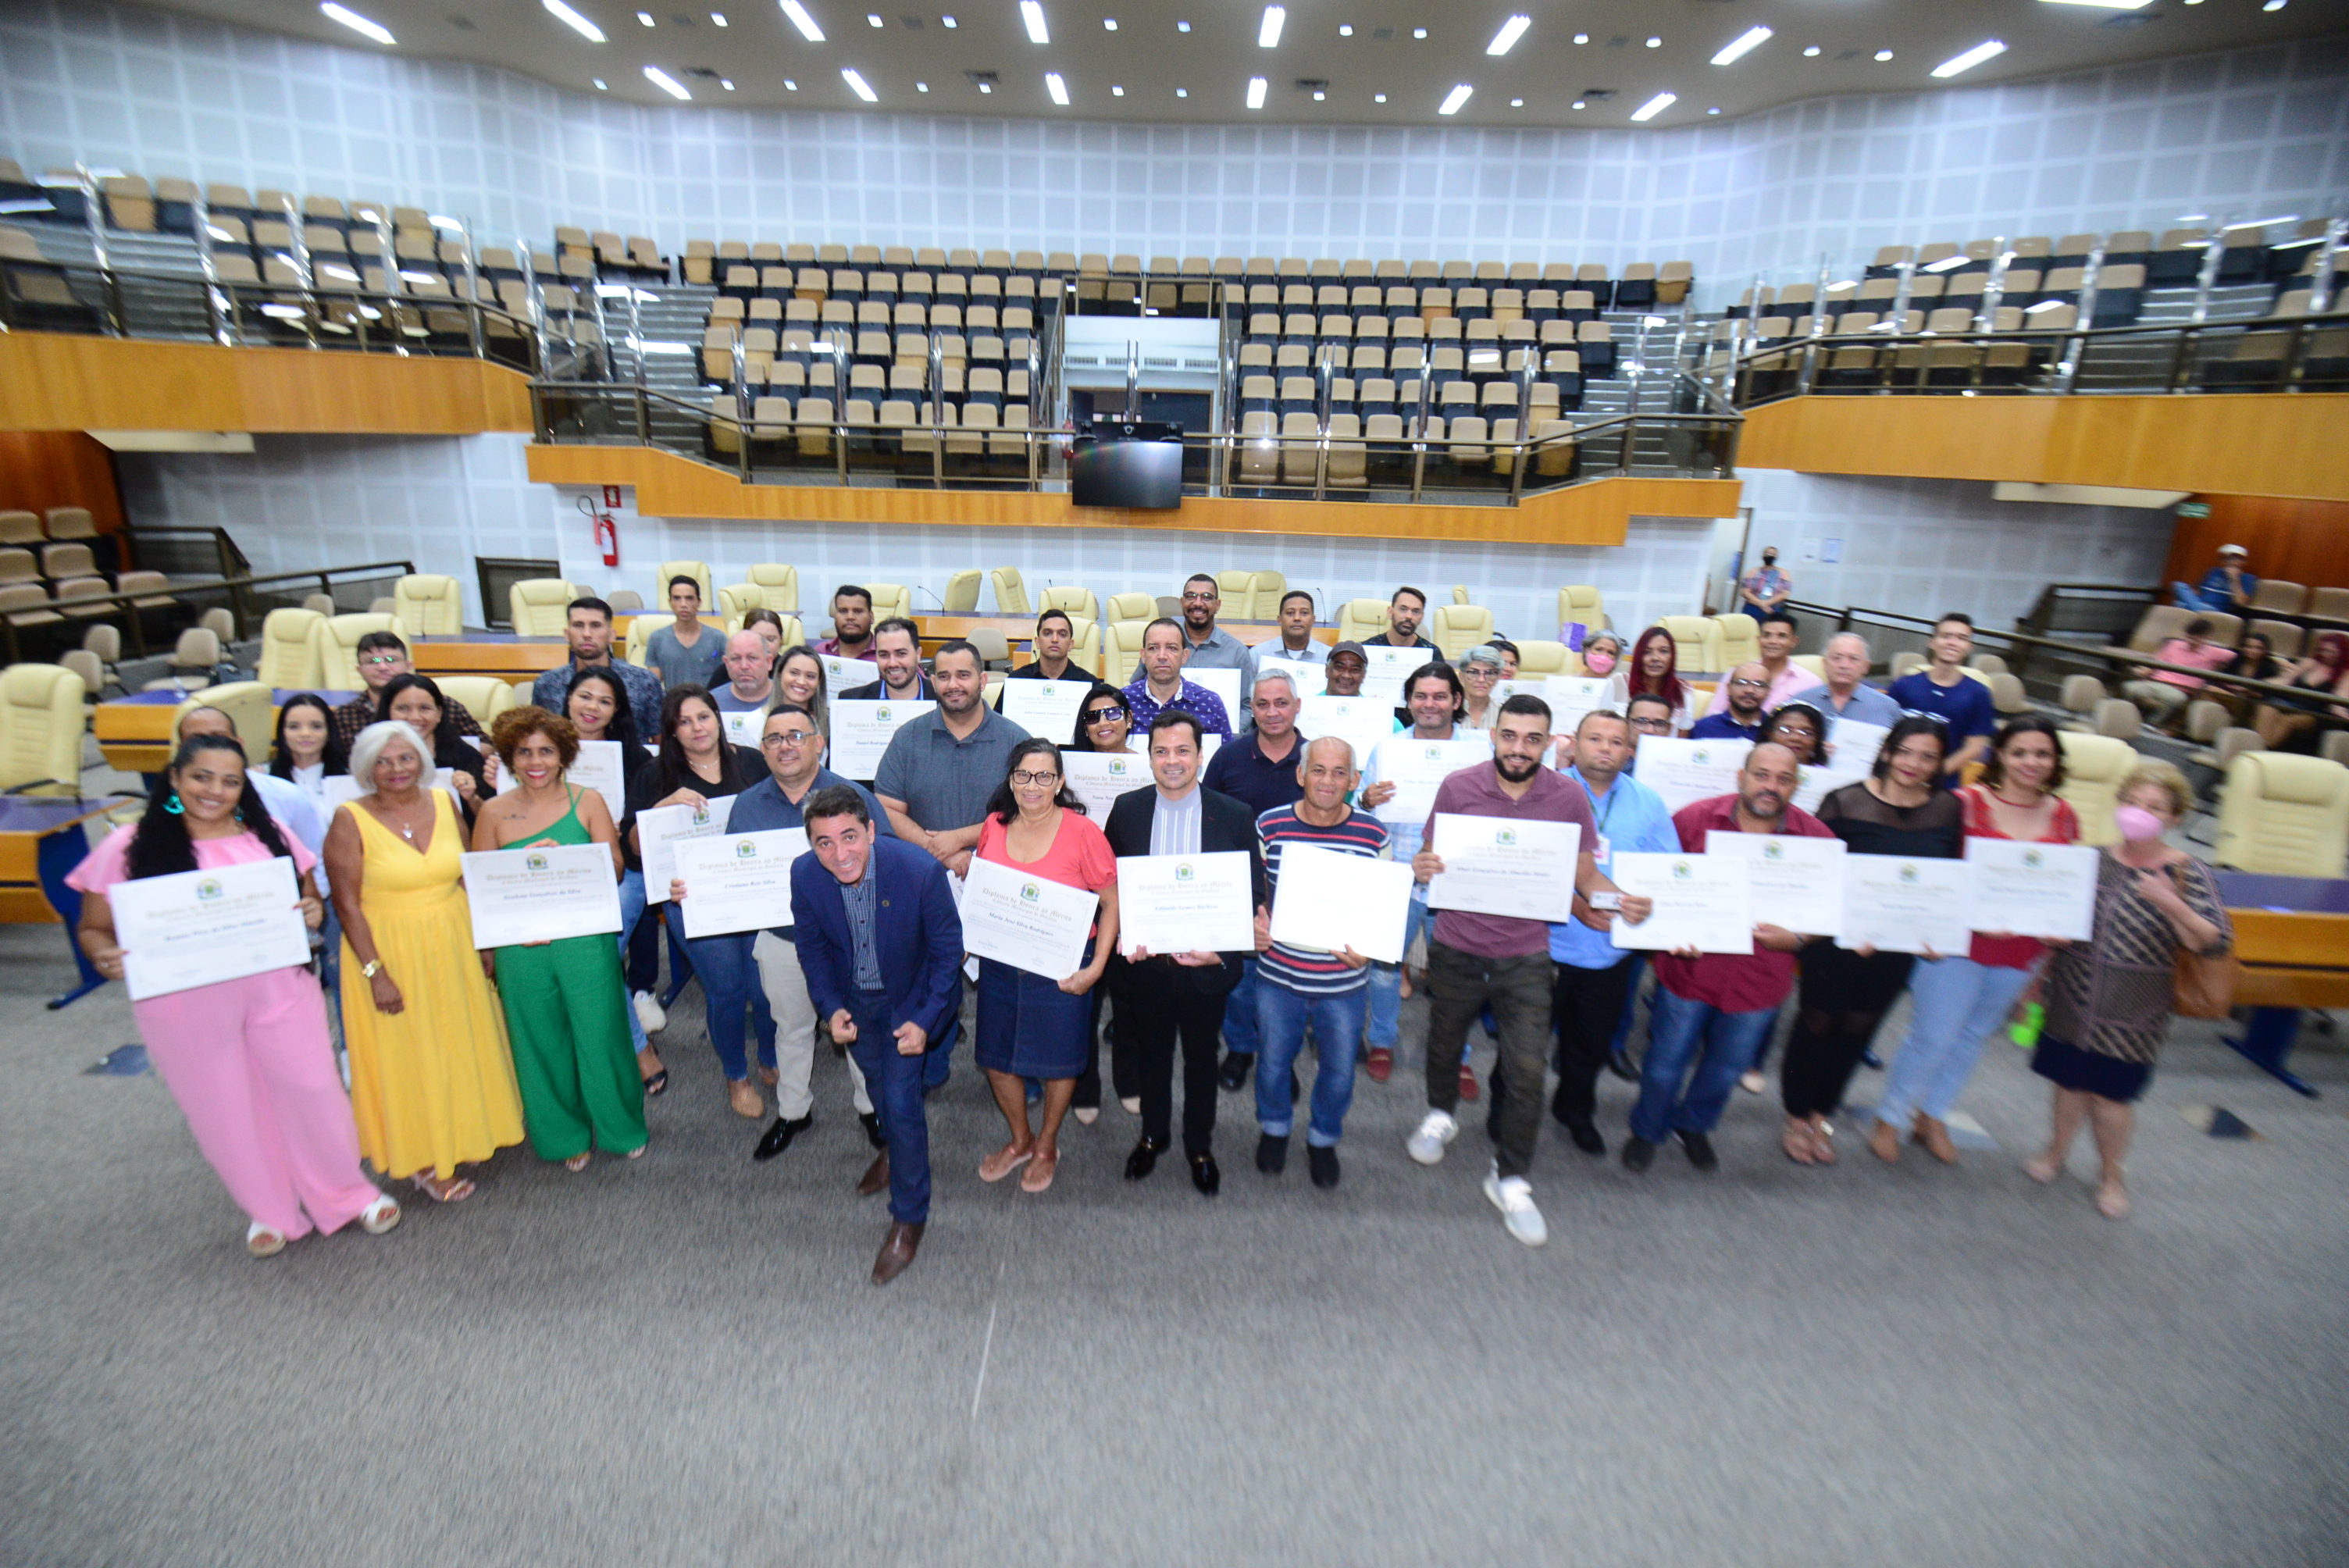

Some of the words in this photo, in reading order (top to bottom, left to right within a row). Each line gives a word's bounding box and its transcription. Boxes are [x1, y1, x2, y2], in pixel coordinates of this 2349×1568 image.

[699, 862, 729, 871] Diploma
[982, 887, 1009, 903] Diploma
[1019, 898, 1039, 911] Honra
[1050, 909, 1072, 921] Mérito
[993, 898, 1010, 907] Câmara
[1011, 903, 1033, 914] Municipal
[988, 912, 1003, 921] Maria
[1003, 916, 1016, 925] José
[1016, 919, 1028, 929] Silva
[1029, 924, 1053, 937] Rodrigues
